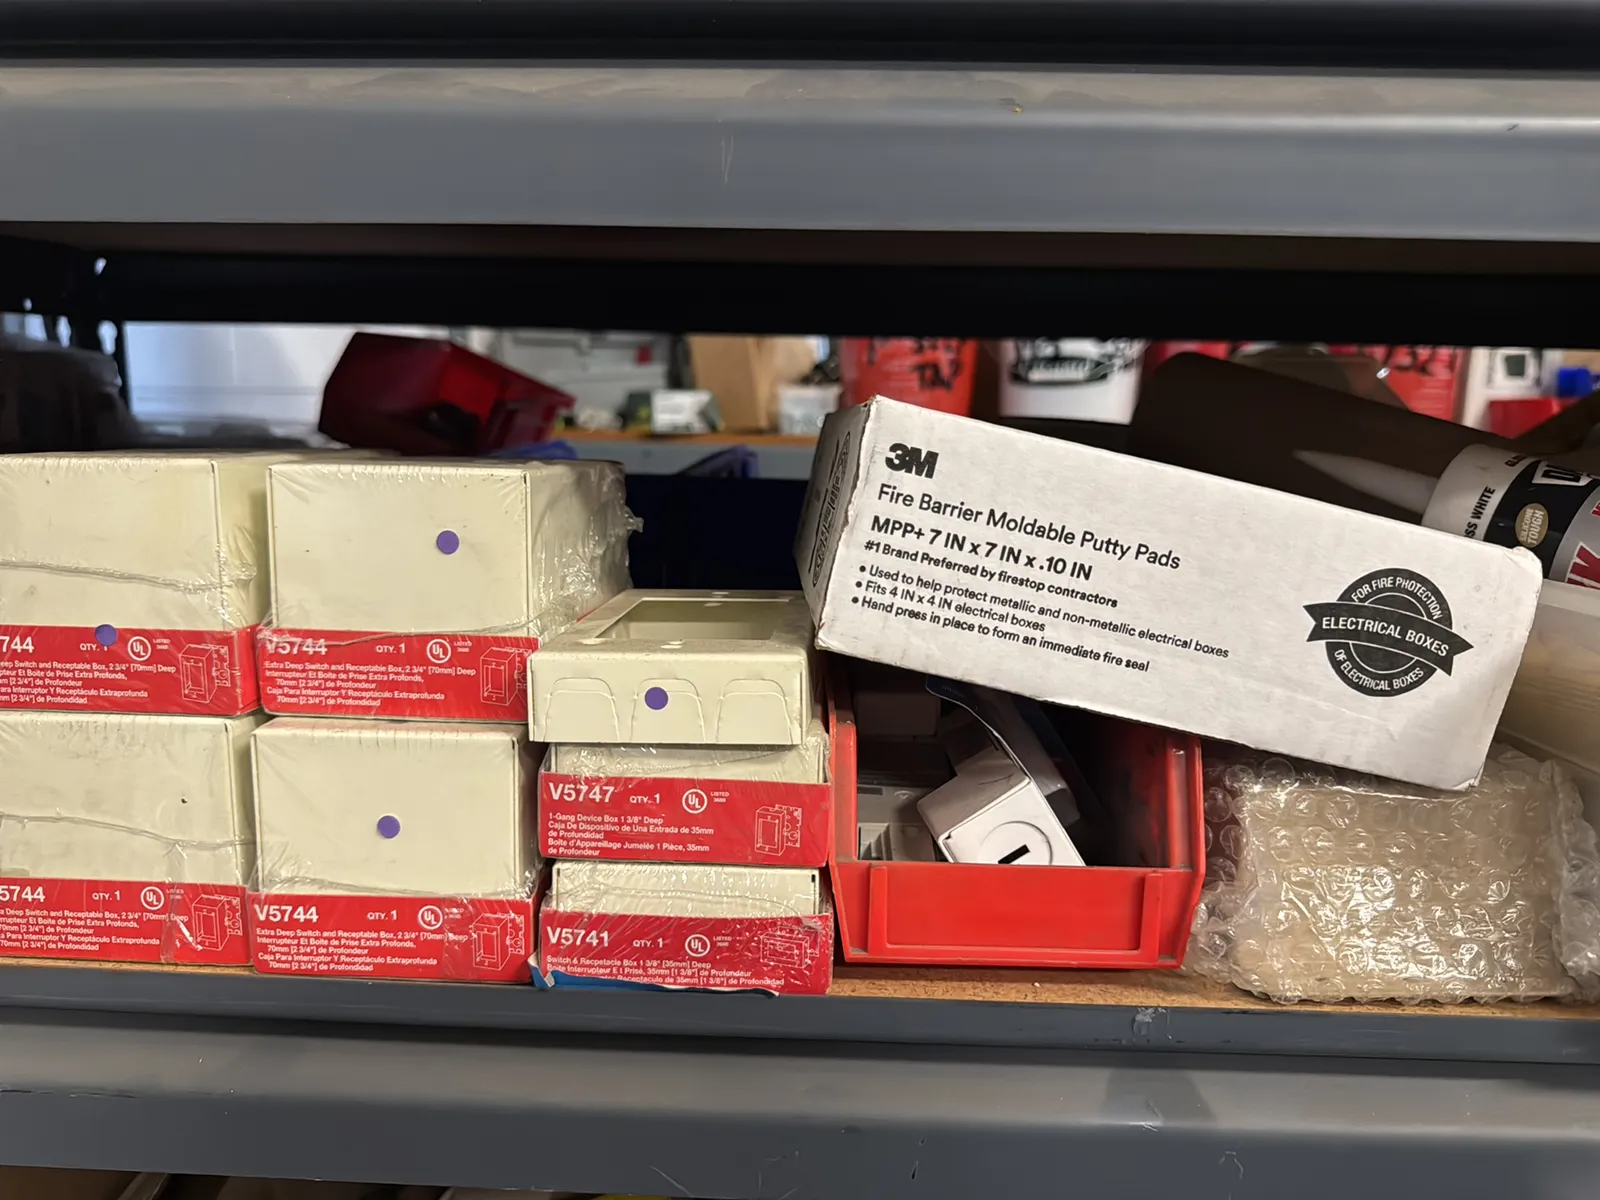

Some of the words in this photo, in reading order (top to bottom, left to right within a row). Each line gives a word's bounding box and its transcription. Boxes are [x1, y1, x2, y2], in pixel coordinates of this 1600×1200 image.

[885, 443, 938, 478] 3M
[1471, 486, 1495, 520] WHITE
[878, 483, 913, 506] Fire
[918, 493, 982, 522] Barrier
[986, 508, 1075, 544] Moldable
[1080, 530, 1131, 560] Putty
[1134, 543, 1180, 568] Pads
[1528, 510, 1544, 544] TOUGH
[871, 515, 924, 539] MPP+
[929, 528, 942, 544] 7
[944, 532, 966, 551] IN
[968, 542, 980, 555] x
[984, 541, 997, 557] 7
[999, 545, 1021, 564] IN
[1024, 555, 1036, 567] x
[1038, 556, 1066, 574] .10
[1070, 561, 1092, 580] IN
[864, 540, 880, 552] #1
[882, 544, 918, 561] Brand
[920, 553, 978, 575] Preferred
[980, 567, 996, 581] by
[998, 571, 1045, 592] firestop
[1047, 584, 1117, 607] contractors
[865, 580, 886, 594] Fits
[889, 587, 897, 597] 4
[900, 588, 915, 601] IN
[916, 594, 924, 603] x
[926, 595, 934, 605] 4
[938, 597, 952, 609] IN
[954, 602, 1008, 622] electrical
[1010, 614, 1045, 631] boxes
[1351, 586, 1371, 603] FOR
[1372, 577, 1394, 591] FIRE
[1396, 577, 1443, 620] PROTECTION
[869, 565, 899, 581] Used
[901, 573, 913, 584] to
[916, 576, 941, 592] help
[943, 585, 987, 601] protect
[989, 595, 1035, 612] metallic
[1037, 606, 1061, 618] and
[1062, 612, 1136, 636] non-metallic
[1137, 628, 1192, 649] electrical
[1193, 640, 1228, 657] boxes
[861, 596, 894, 613] Hand
[894, 606, 926, 620] press
[929, 611, 940, 624] in
[942, 616, 974, 631] place
[977, 623, 989, 634] to
[992, 626, 1019, 641] form
[1022, 635, 1036, 646] an
[1039, 636, 1100, 660] immediate
[1102, 651, 1122, 665] fire
[1124, 659, 1149, 671] seal
[1322, 617, 1402, 638] ELECTRICAL
[1405, 630, 1449, 657] BOXES
[266, 638, 328, 655] V5744
[375, 644, 396, 653] QTY.
[398, 644, 405, 653] 1
[1334, 649, 1346, 663] OF
[1340, 661, 1391, 690] ELECTRICAL
[1393, 667, 1424, 689] BOXES
[548, 782, 614, 802] V5747
[629, 795, 652, 804] QTY.
[653, 795, 659, 804] 1
[549, 813, 575, 822] 1-Gang
[603, 814, 618, 822] Box
[643, 816, 663, 824] Deep
[548, 822, 565, 831] Caja
[578, 823, 619, 832] Dispositivo
[632, 824, 647, 832] Una
[649, 825, 678, 833] Entrada
[690, 826, 714, 834] 35mm
[559, 830, 604, 839] Profundidad
[558, 847, 600, 856] Profondeur
[686, 843, 709, 851] 35mm
[92, 892, 112, 900] QTY.
[114, 891, 120, 900] 1
[254, 904, 318, 922] V5744
[366, 911, 388, 920] QTY.
[390, 911, 396, 921] 1
[275, 928, 295, 937] Deep
[379, 931, 396, 939] Box,
[547, 927, 608, 946] V5741
[632, 938, 653, 948] QTY.
[657, 938, 663, 948] 1
[662, 959, 690, 968] [35mm]
[691, 960, 711, 969] Deep
